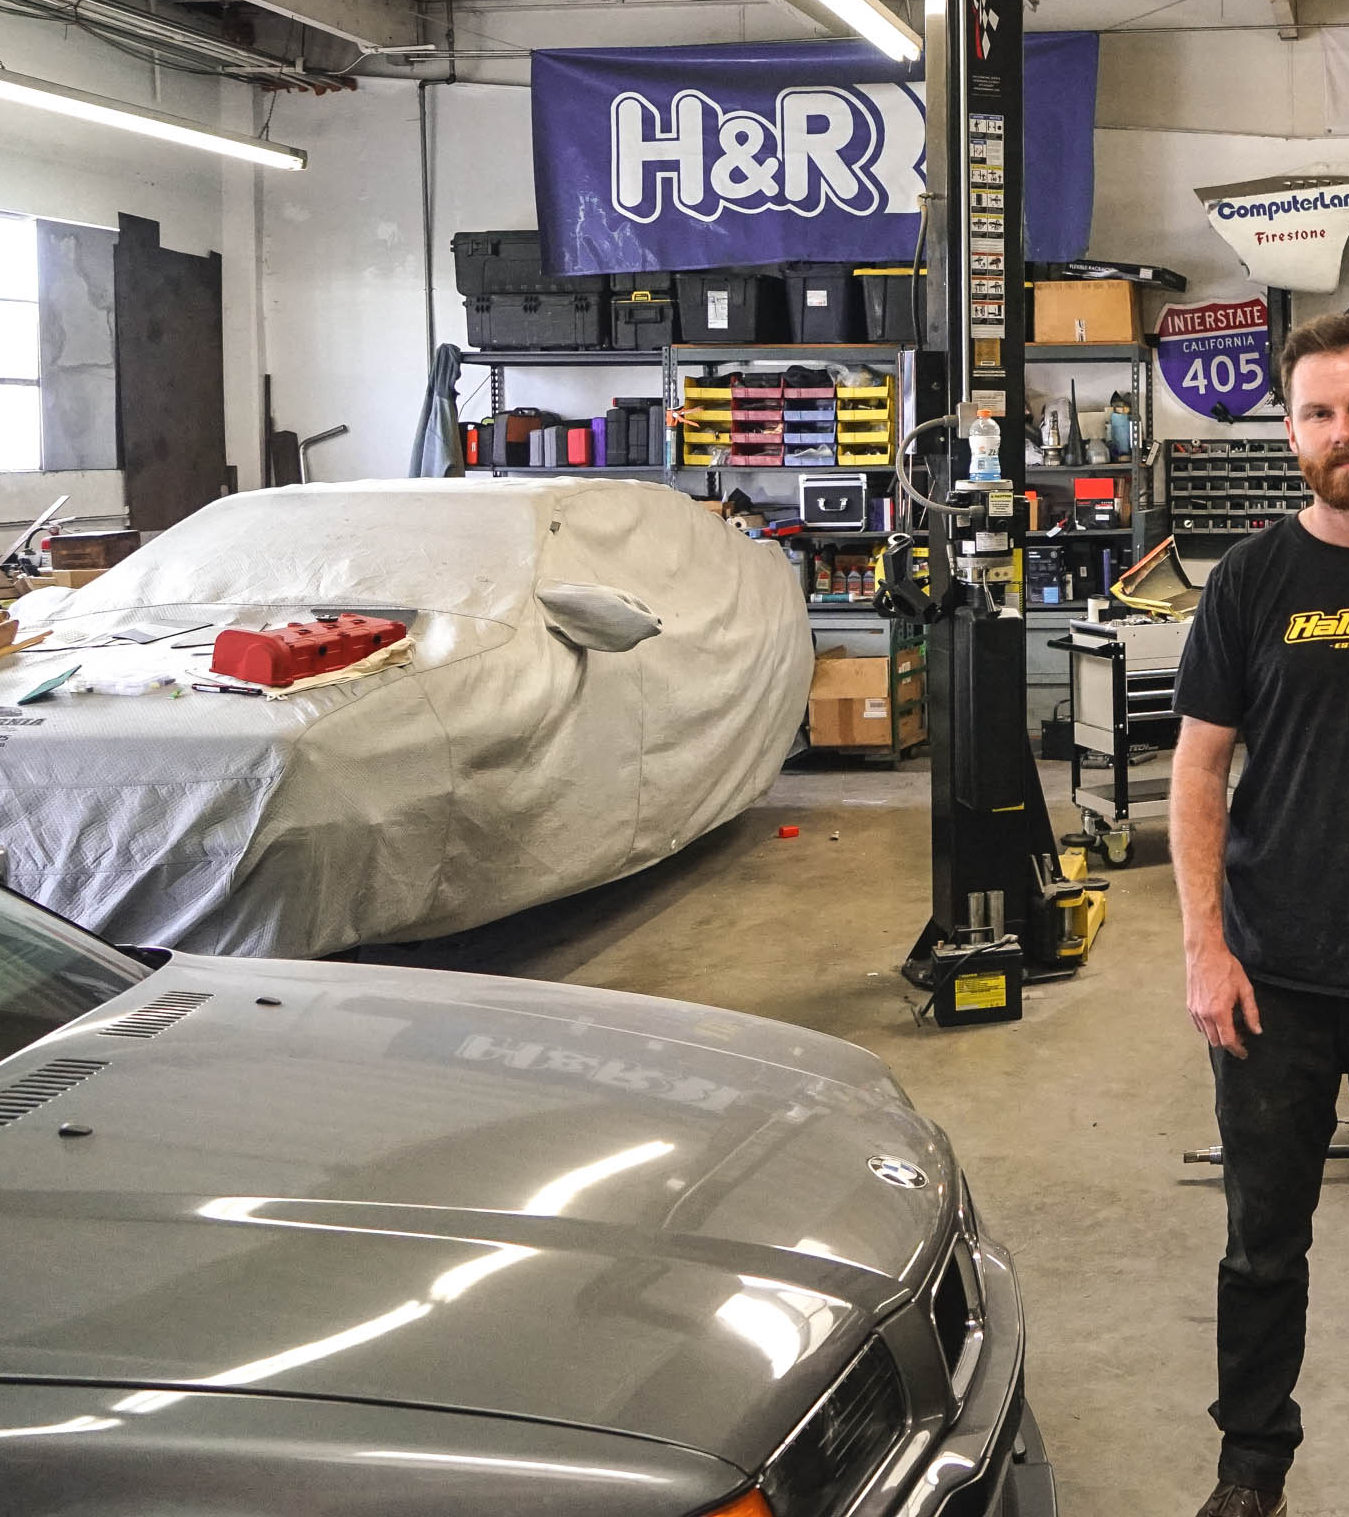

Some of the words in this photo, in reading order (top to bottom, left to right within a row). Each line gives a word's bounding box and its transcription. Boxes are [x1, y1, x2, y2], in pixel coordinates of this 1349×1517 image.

[611, 87, 879, 223] H&R
[1254, 229, 1326, 246] Firestone
[1167, 305, 1263, 333] INTERSTATE
[1182, 334, 1255, 353] CALIFORNIA
[1182, 352, 1264, 395] 405
